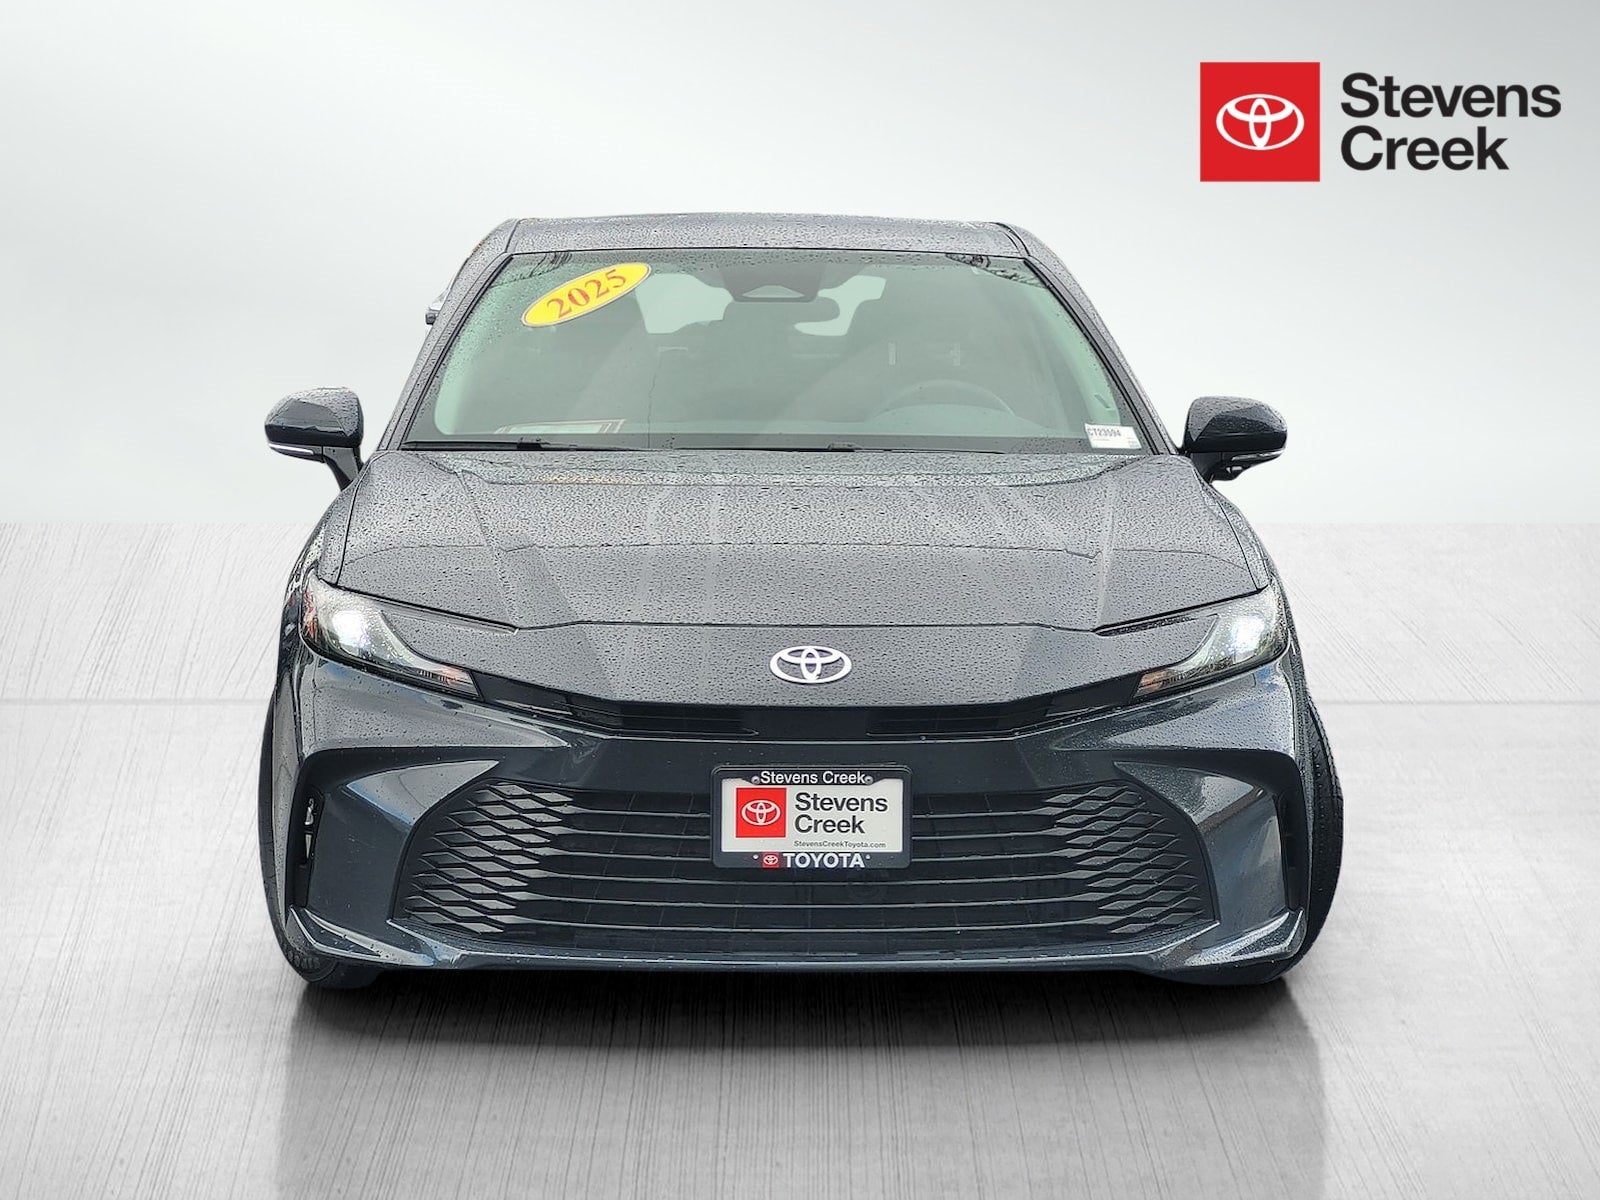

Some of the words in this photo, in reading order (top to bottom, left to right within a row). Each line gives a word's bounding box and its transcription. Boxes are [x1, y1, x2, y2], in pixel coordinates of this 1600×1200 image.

[546, 268, 627, 319] 2025
[760, 770, 818, 784] Stevens
[822, 770, 866, 784] Creek
[794, 791, 888, 812] Stevens
[794, 813, 866, 834] Creek
[793, 840, 887, 849] StevensCreekToyota.com
[783, 853, 866, 868] TOYOTA
